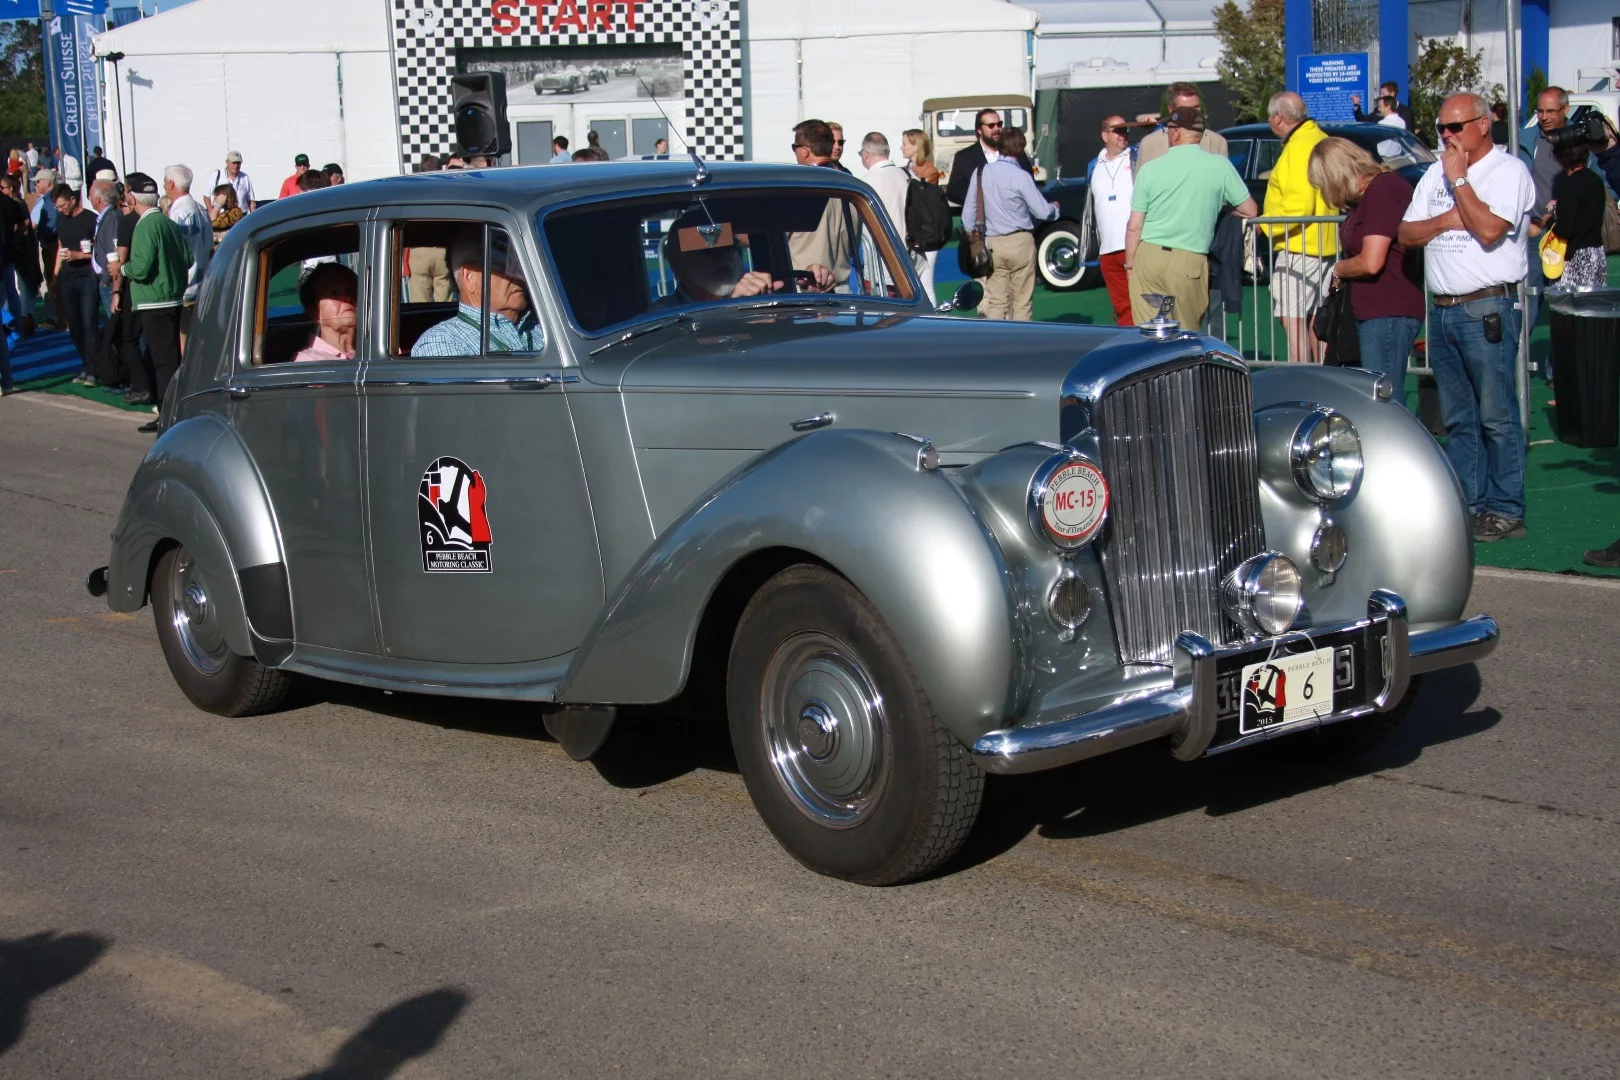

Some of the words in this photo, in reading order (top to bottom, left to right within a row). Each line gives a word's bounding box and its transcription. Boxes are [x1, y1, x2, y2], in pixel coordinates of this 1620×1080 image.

[491, 0, 645, 34] START
[61, 32, 76, 80] SUISSE
[64, 82, 79, 136] CREDIT
[1050, 467, 1076, 491] PEBBLE
[1077, 466, 1100, 487] BEACH
[1055, 489, 1094, 511] MC-15
[426, 530, 434, 545] 6
[457, 552, 477, 560] BEACH
[1287, 662, 1310, 672] PEBBLE
[1311, 657, 1331, 667] BEACH
[1302, 670, 1314, 700] 6
[1256, 716, 1273, 727] 2015
